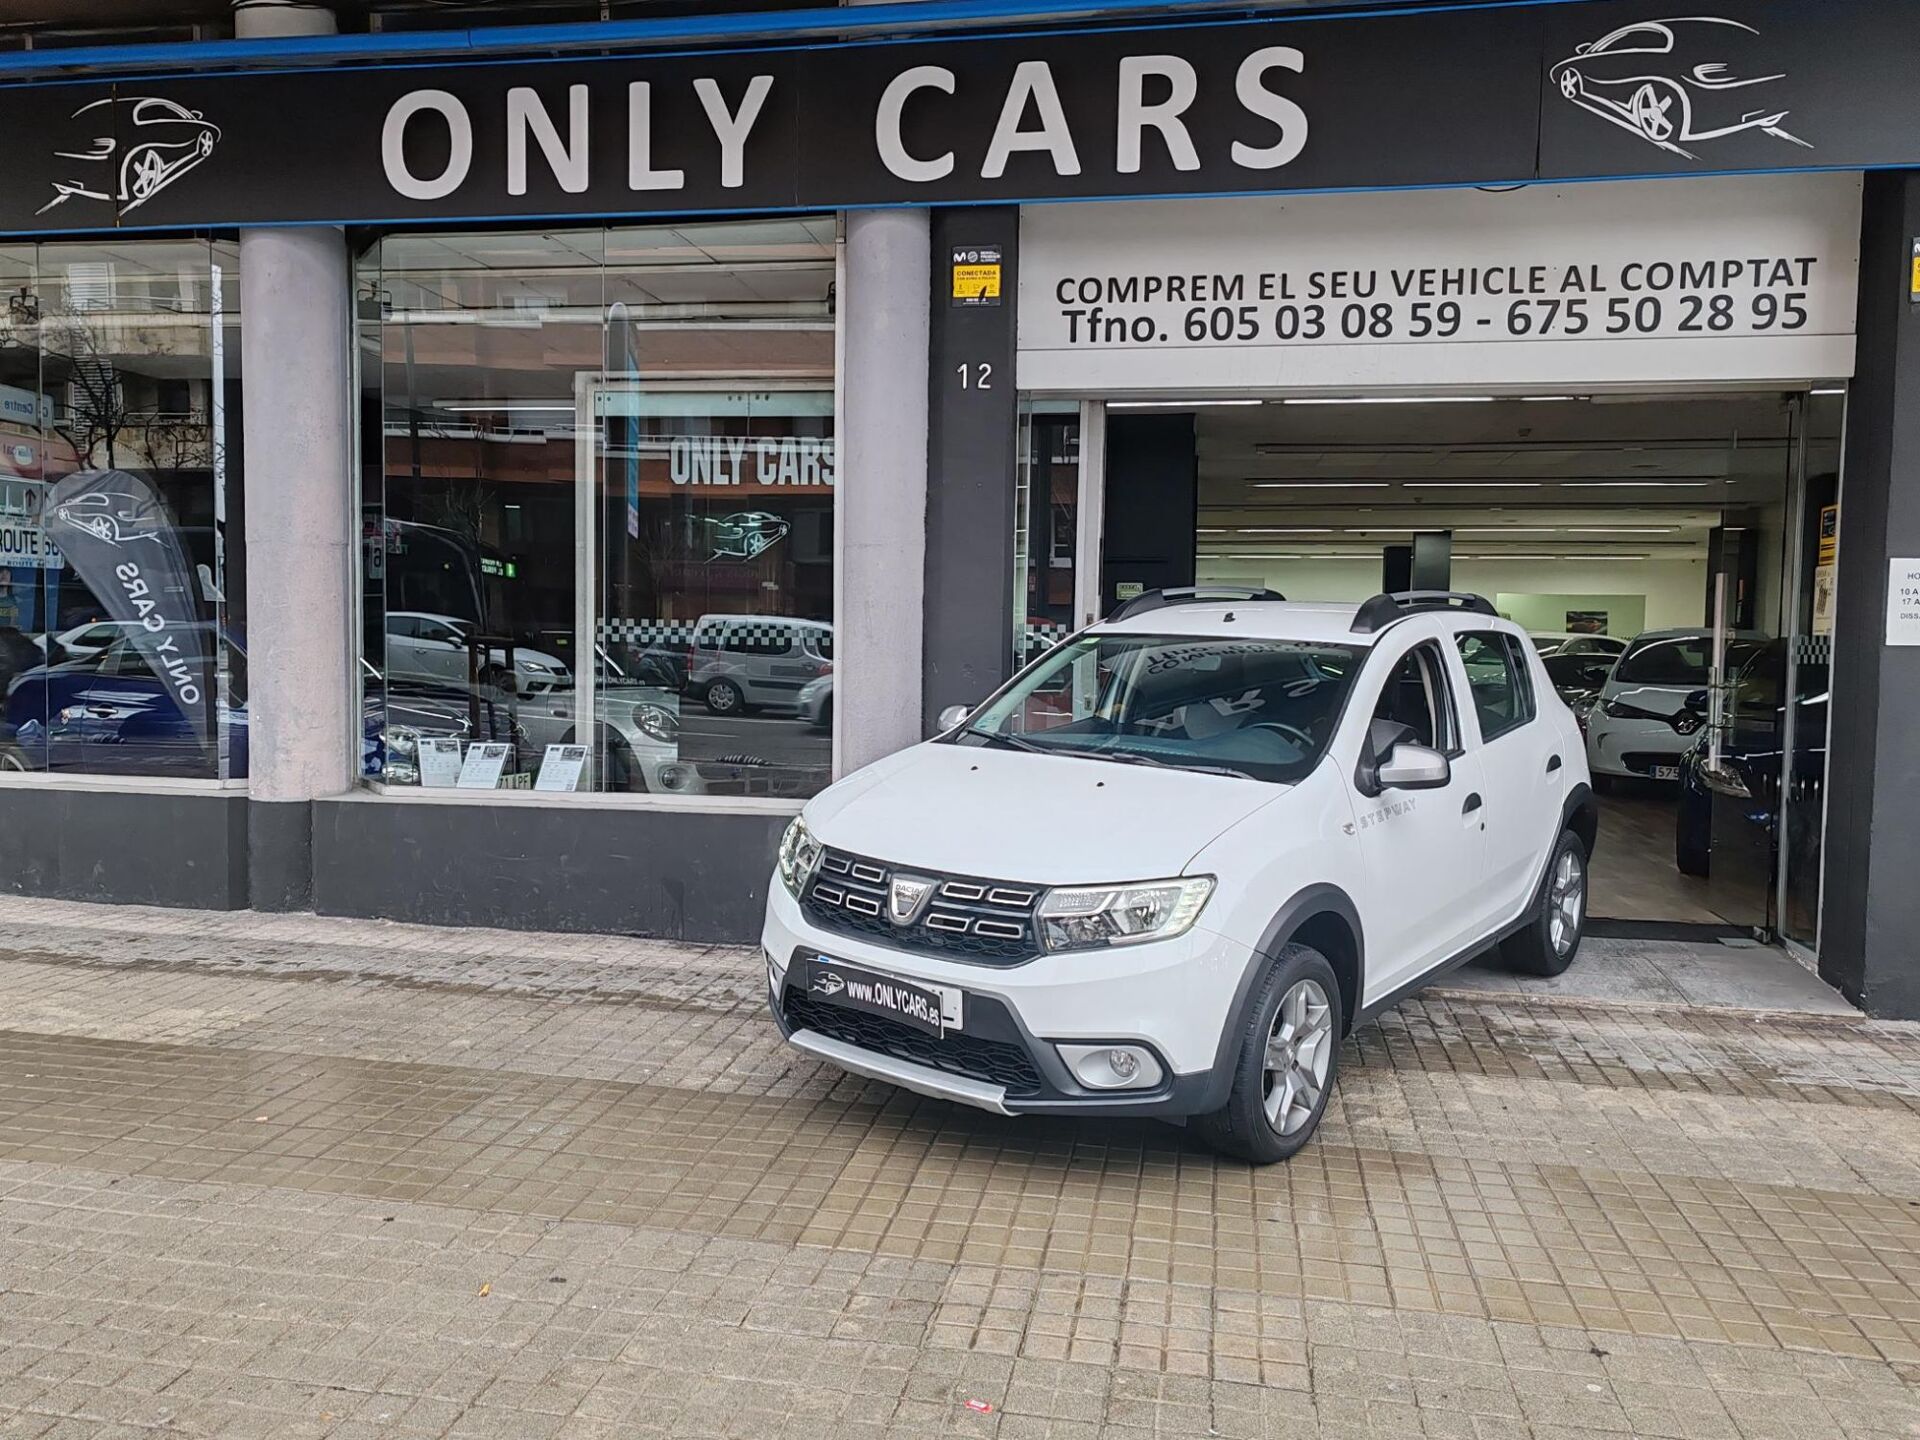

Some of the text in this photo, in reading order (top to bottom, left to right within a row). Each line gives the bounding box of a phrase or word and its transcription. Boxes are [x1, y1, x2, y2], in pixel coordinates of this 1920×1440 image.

[382, 47, 1307, 199] ONLY CARS
[1057, 258, 1817, 304] COMPREM EL SEU VEHICLE AL COMPTAT
[1062, 306, 1167, 343] Tfno.
[1185, 306, 1259, 341] 605
[1276, 305, 1325, 339] 03
[1342, 303, 1393, 338] 08
[1410, 302, 1460, 337] 59
[1507, 299, 1589, 335] 675
[1606, 297, 1661, 333] 50
[1678, 294, 1733, 331] 28
[1751, 293, 1807, 330] 95
[957, 363, 992, 389] 12
[670, 436, 834, 486] ONLY CARS
[1360, 797, 1416, 829] STEPWAY
[895, 884, 923, 894] DACIA
[847, 981, 940, 1027] www.ONLYCARS.es
